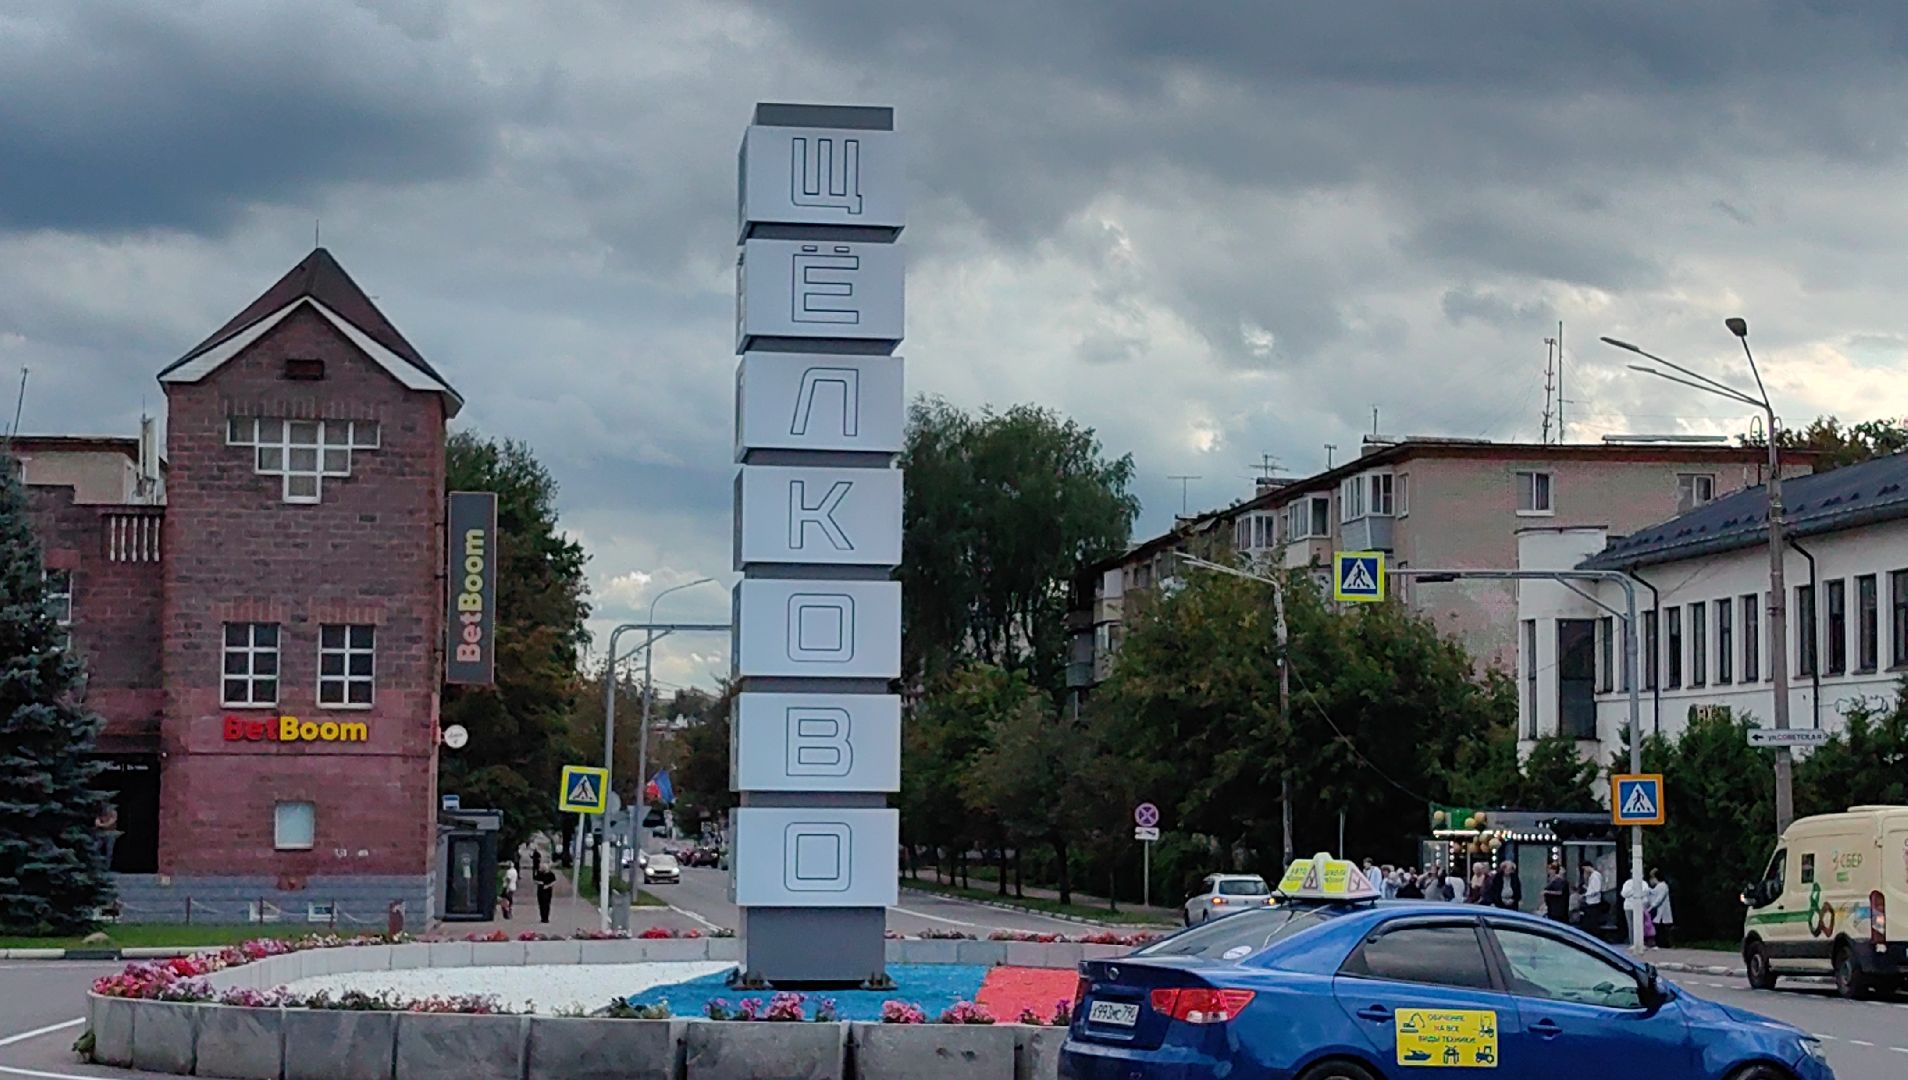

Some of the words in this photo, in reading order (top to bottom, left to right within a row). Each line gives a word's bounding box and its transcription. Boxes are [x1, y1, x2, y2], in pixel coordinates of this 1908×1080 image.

[784, 137, 862, 892] ЩЁЛКОВО
[457, 528, 485, 662] BetBoom
[223, 715, 369, 742] BetBoom
